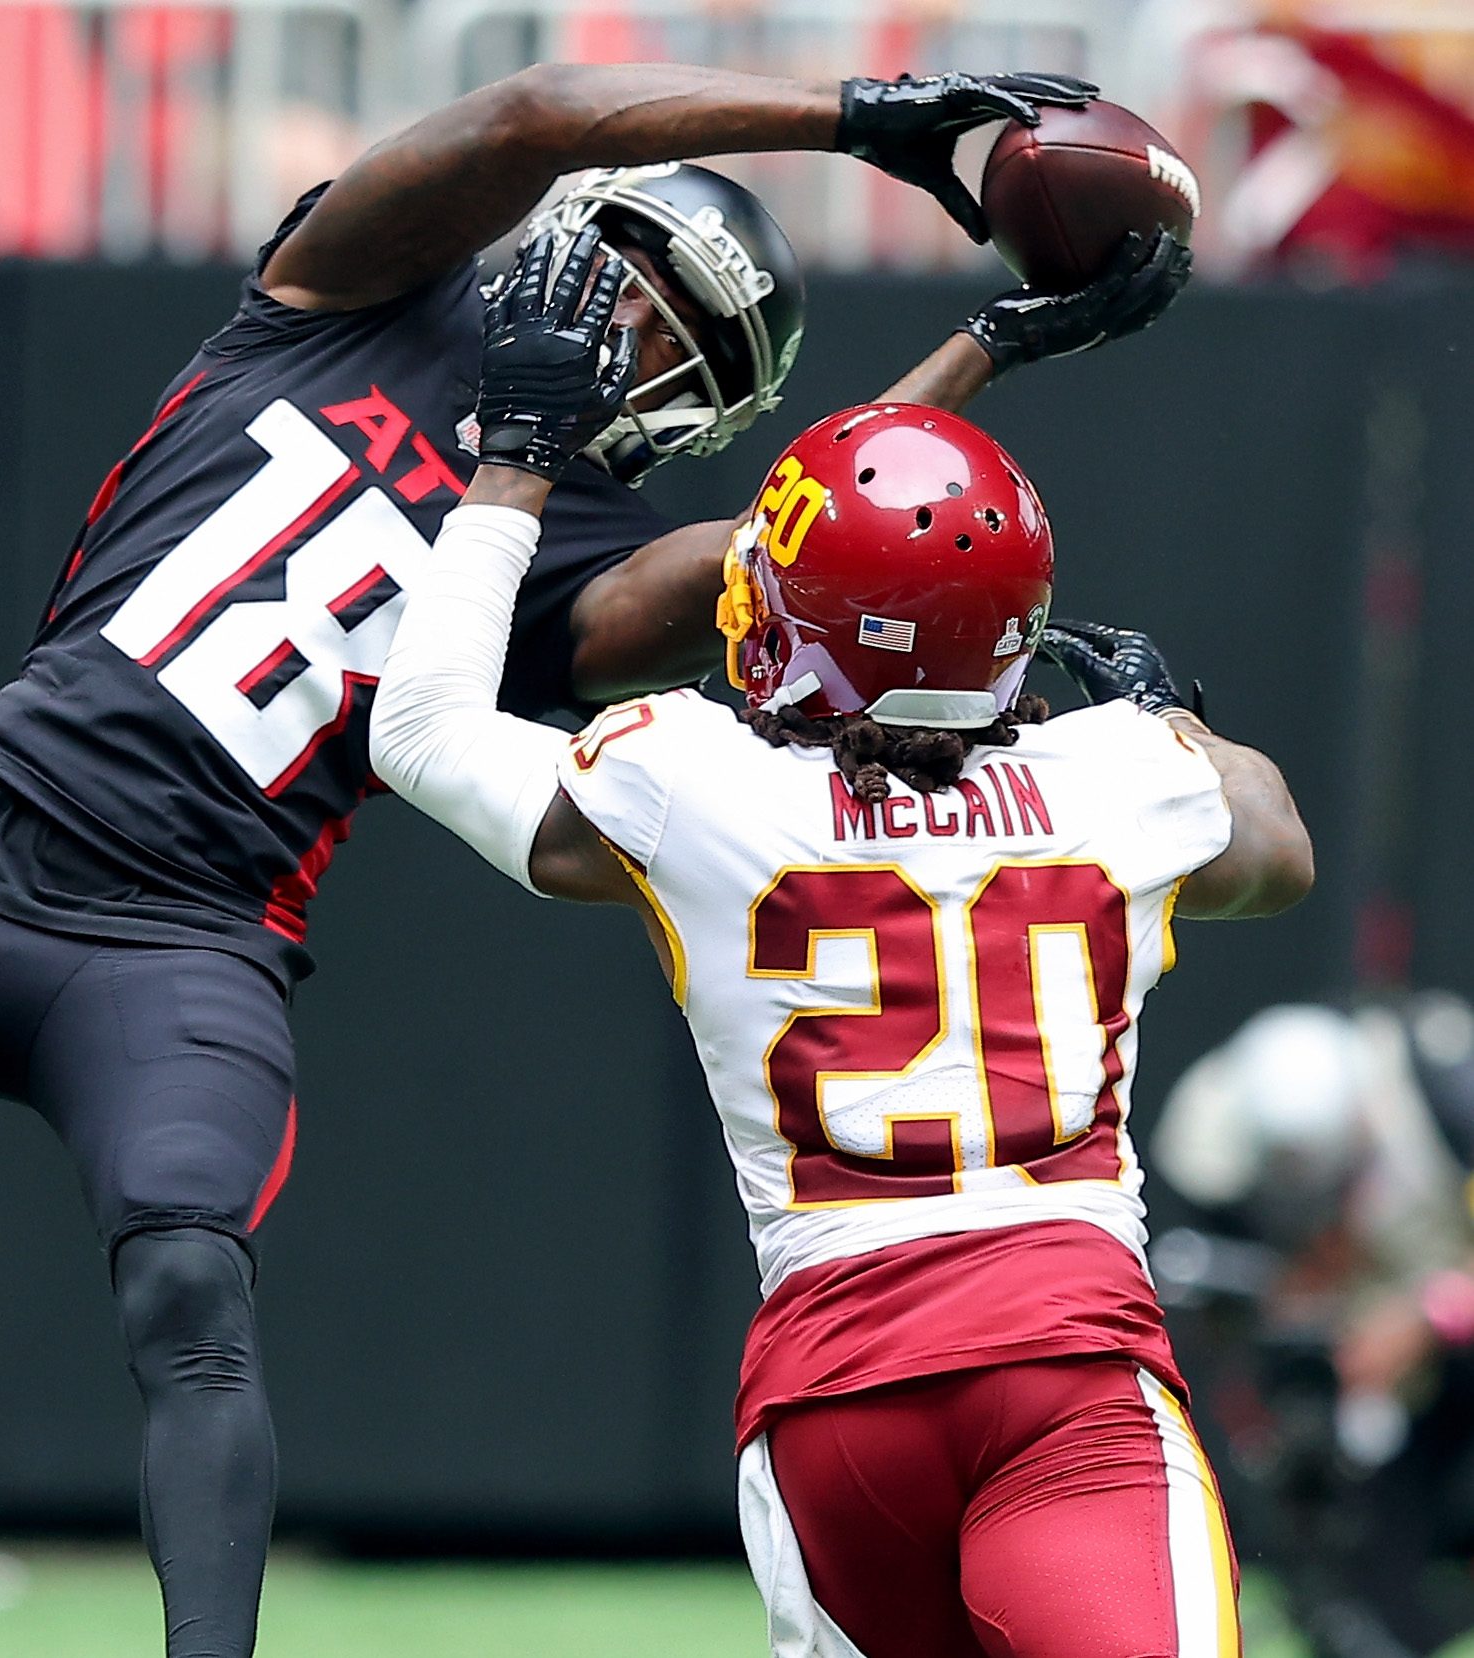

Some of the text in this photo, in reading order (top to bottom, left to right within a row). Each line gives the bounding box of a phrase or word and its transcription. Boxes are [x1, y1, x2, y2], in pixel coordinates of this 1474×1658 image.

[318, 383, 467, 503] AT
[754, 455, 826, 568] 20
[99, 397, 434, 798] 18
[745, 857, 1130, 1211] 20
